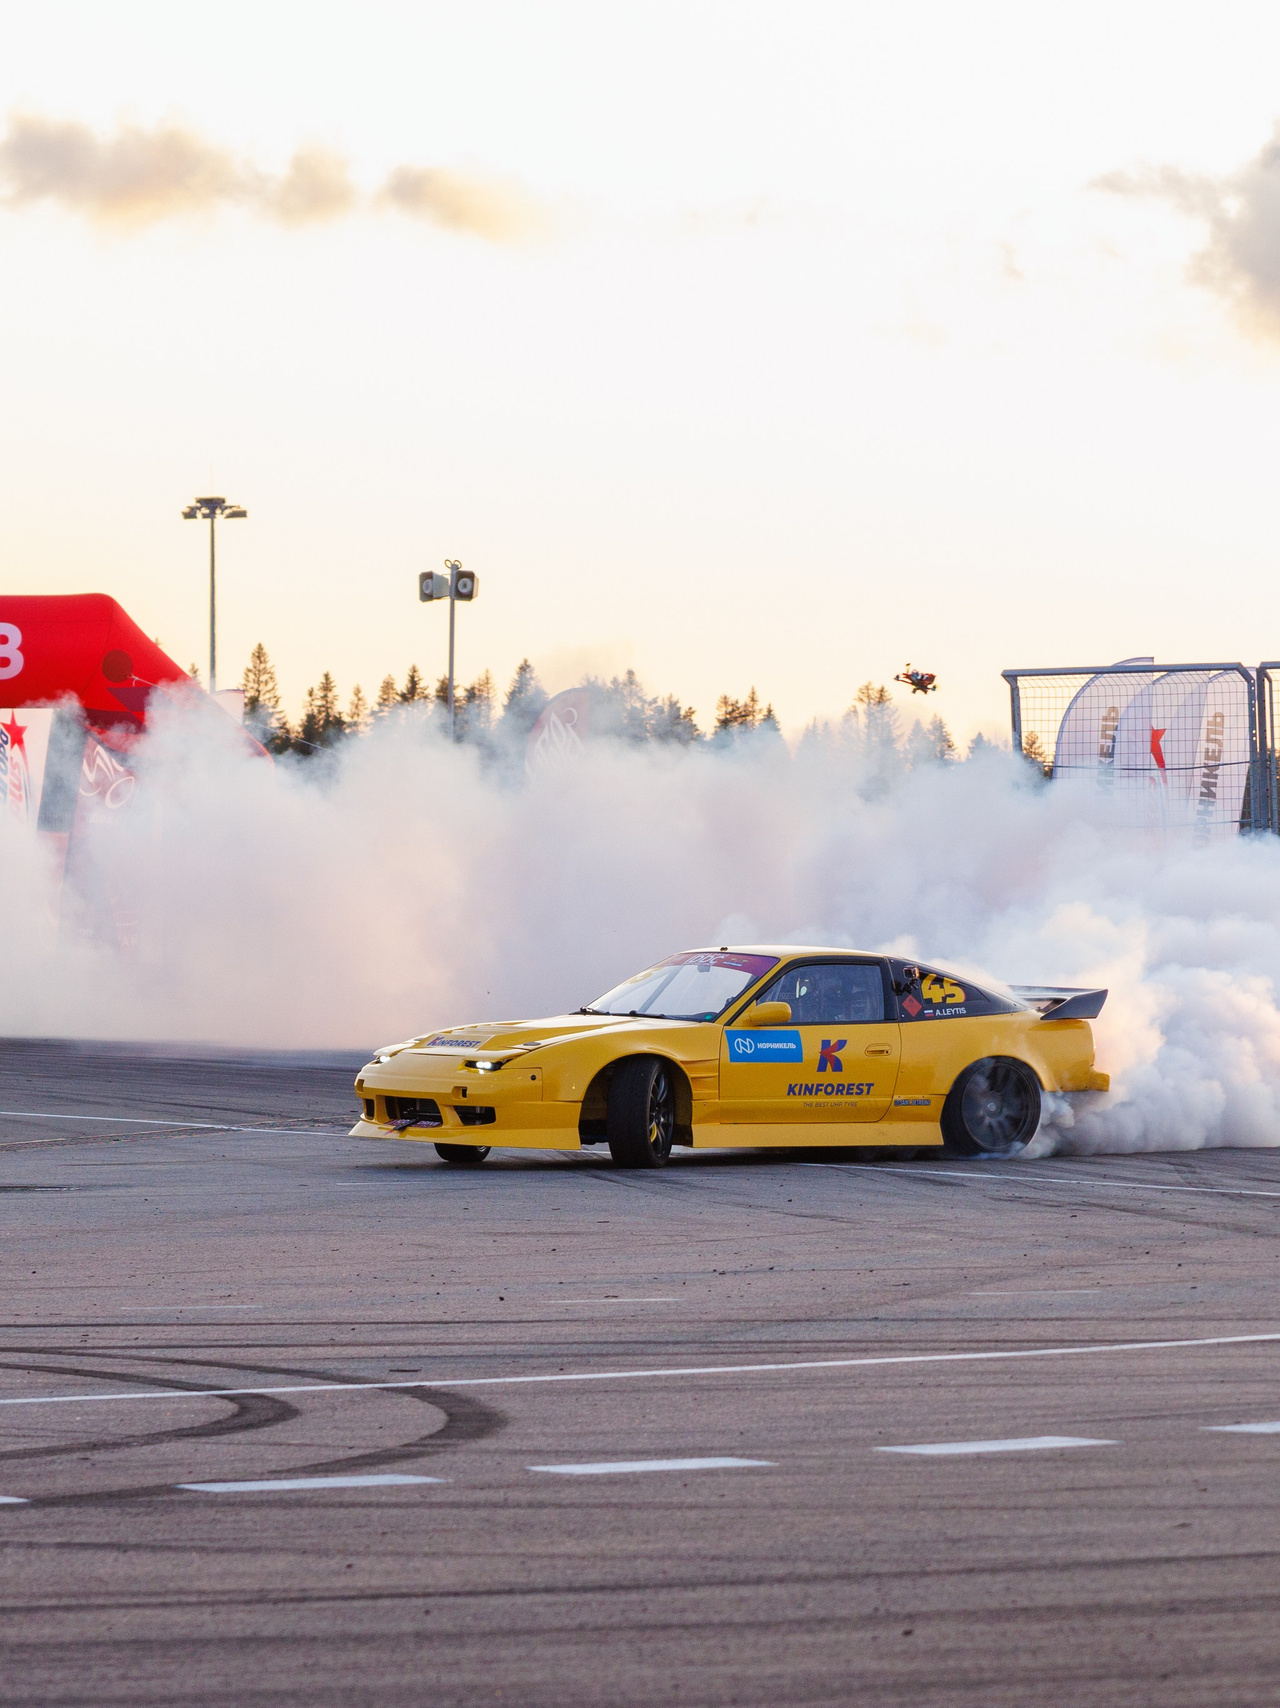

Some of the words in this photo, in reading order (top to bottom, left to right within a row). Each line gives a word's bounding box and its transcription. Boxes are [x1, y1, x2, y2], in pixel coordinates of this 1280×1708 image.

[921, 973, 967, 1004] 45
[935, 1007, 967, 1016] A.LEYTIS
[787, 1083, 874, 1096] KINFOREST
